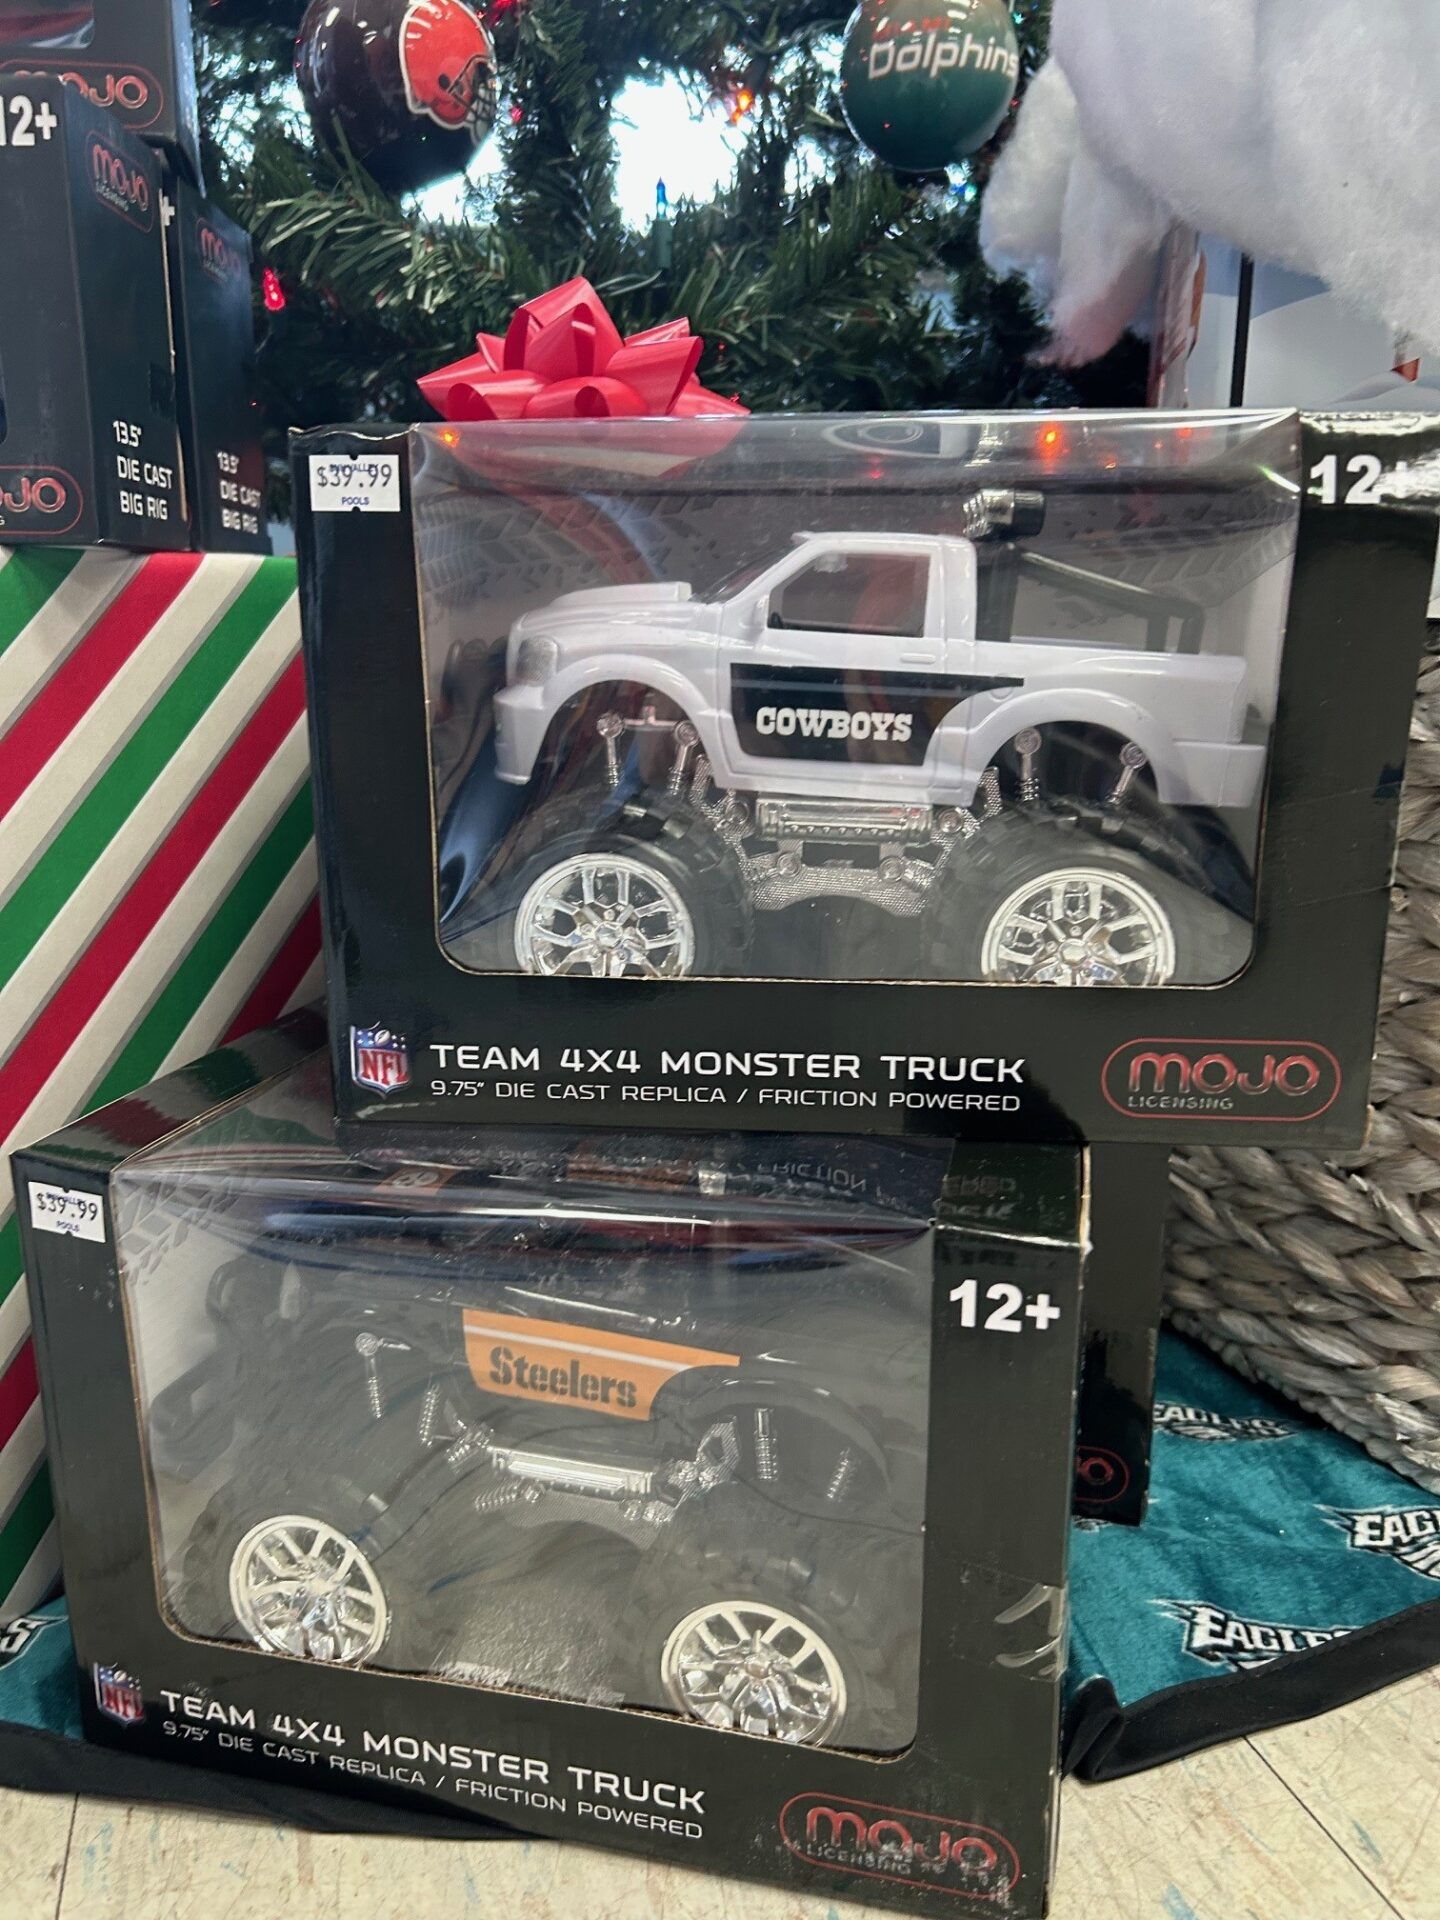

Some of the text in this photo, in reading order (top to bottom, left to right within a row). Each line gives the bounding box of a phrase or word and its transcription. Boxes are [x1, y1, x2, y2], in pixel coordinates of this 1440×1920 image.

[870, 33, 1018, 79] Dolphins
[117, 456, 173, 490] DIE CAST
[317, 464, 392, 487] $39.99
[120, 491, 168, 520] BIG RIG
[341, 497, 369, 506] POOLS
[756, 706, 913, 743] COWBOYS
[359, 1049, 408, 1084] NFL
[430, 1044, 540, 1071] TEAM
[661, 1050, 860, 1079] MONSTER
[880, 1055, 1026, 1083] TRUCK
[496, 1081, 535, 1098] DIE
[546, 1083, 610, 1100] CAST
[622, 1085, 726, 1103] REPLICA
[736, 1088, 749, 1103] /
[759, 1088, 877, 1107] FRICTION
[889, 1091, 1020, 1111] POWERED
[1127, 1096, 1234, 1110] LICENSING
[37, 1192, 98, 1221] $39.99
[950, 1278, 1061, 1333] 12+
[489, 1345, 638, 1408] Steelers
[1188, 1605, 1354, 1652] EAGLE
[101, 1683, 144, 1719] NFL
[160, 1689, 256, 1730] TEAM
[362, 1731, 550, 1784] MONSTER
[567, 1766, 706, 1814] TRUCK
[218, 1732, 254, 1752] DIE
[262, 1742, 320, 1766] CAST
[329, 1755, 426, 1787] REPLICA
[434, 1775, 446, 1789] /
[455, 1778, 567, 1812] FRICTION
[577, 1801, 703, 1839] POWERED
[806, 1843, 912, 1876] LICENSING
